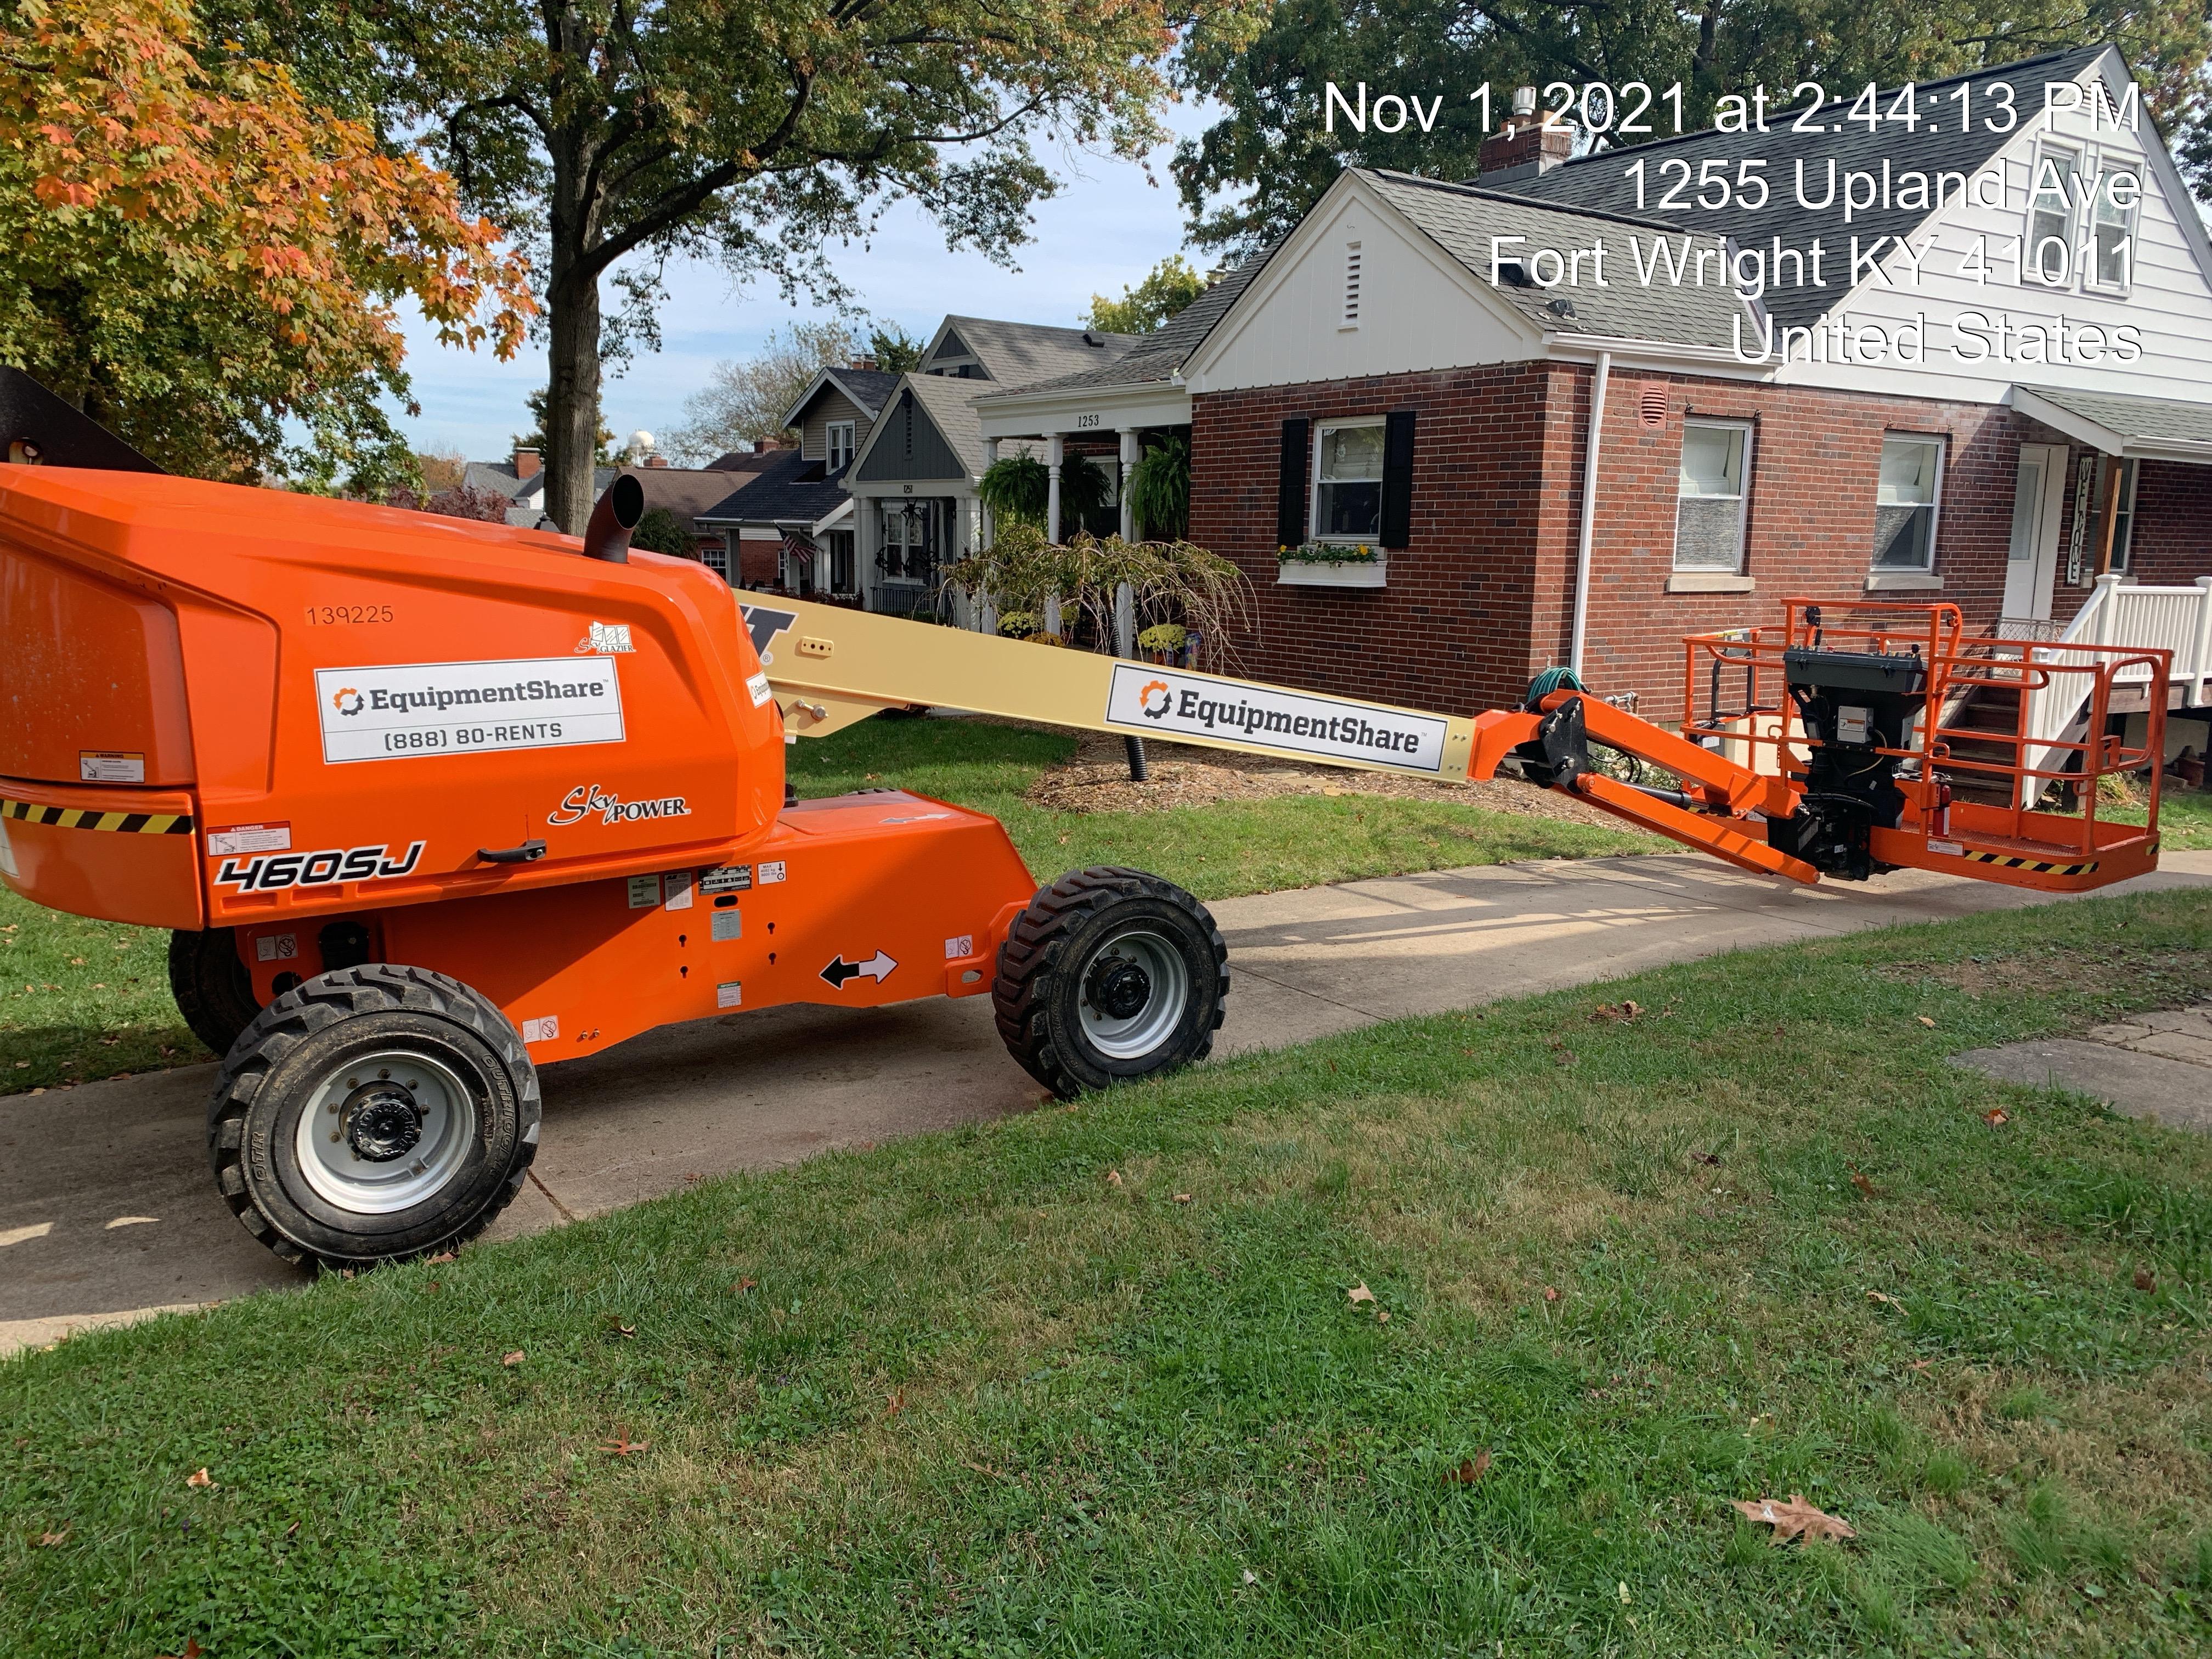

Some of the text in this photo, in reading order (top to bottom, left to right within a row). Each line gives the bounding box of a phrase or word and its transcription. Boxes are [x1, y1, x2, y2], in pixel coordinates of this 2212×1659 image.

[1078, 414, 1099, 427] 1253
[2070, 461, 2091, 579] WELCOME
[307, 605, 394, 625] 139225
[600, 645, 633, 653] GLAZIER
[370, 680, 604, 713] EquipmentShare
[384, 723, 562, 751] (888) 80-RENTS
[1177, 689, 1420, 754] EquipmentShare
[548, 785, 686, 824] Sky POWER
[216, 843, 426, 891] 460SJ
[250, 1131, 268, 1182] OTR
